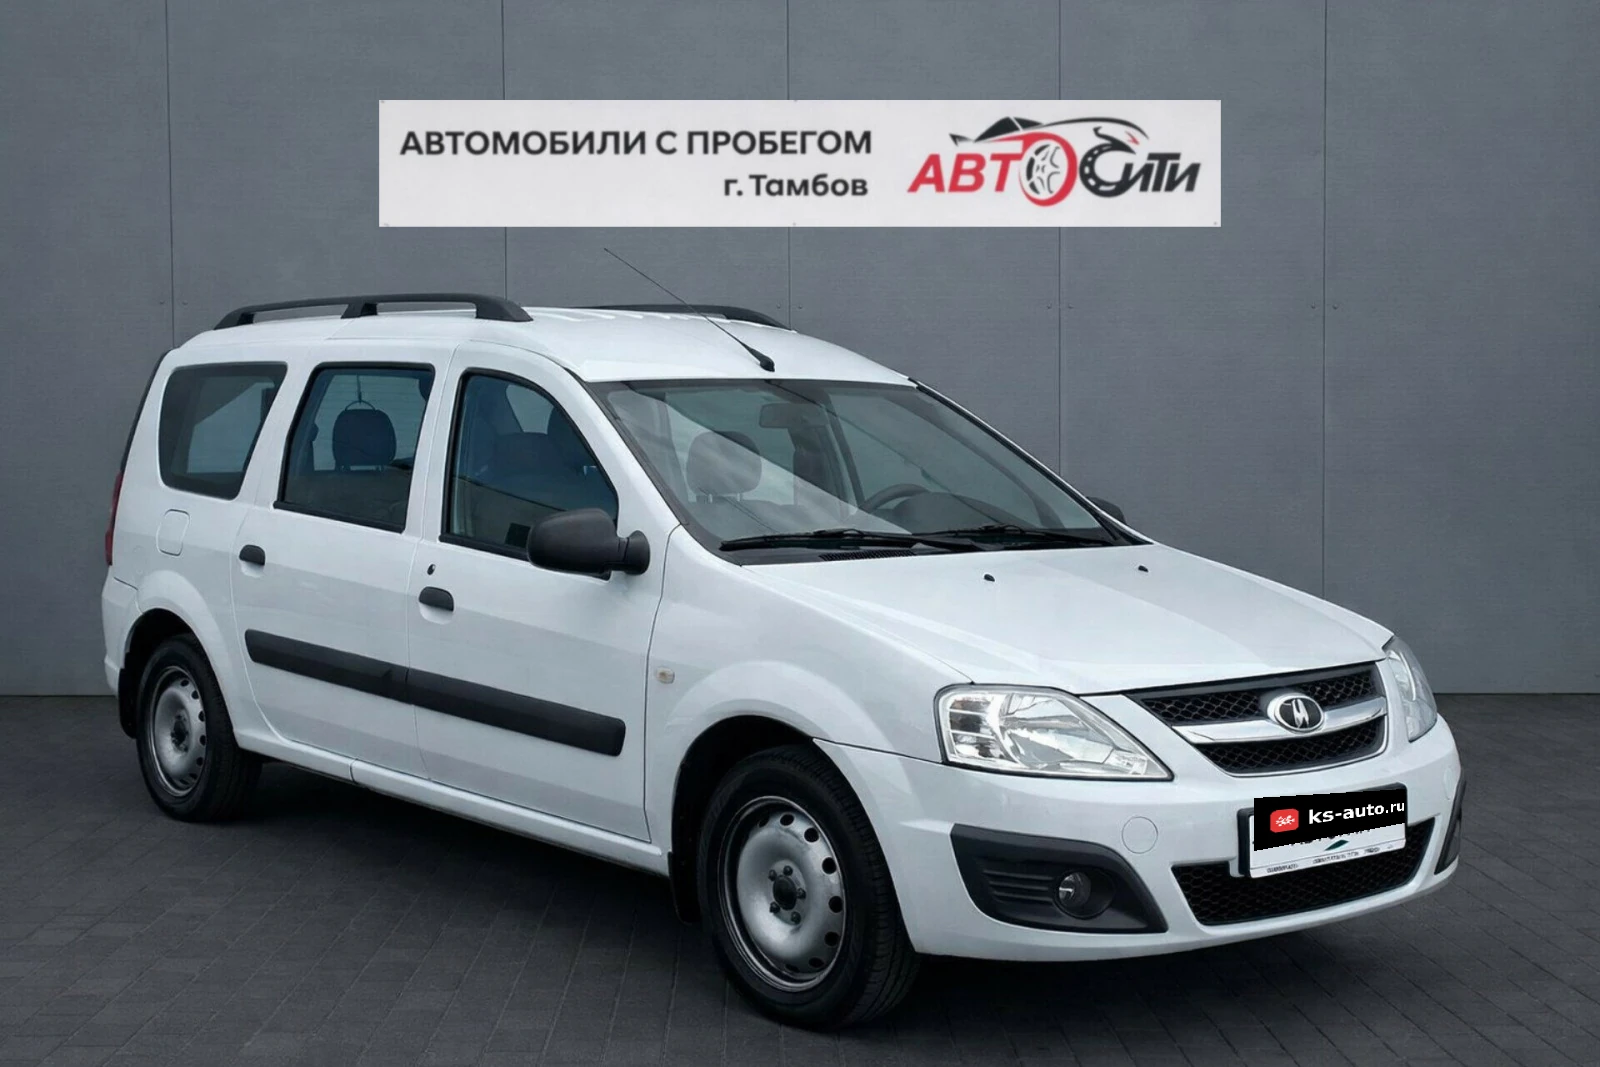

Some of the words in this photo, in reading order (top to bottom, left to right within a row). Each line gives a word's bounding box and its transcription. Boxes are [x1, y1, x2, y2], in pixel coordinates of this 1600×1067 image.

[399, 130, 647, 156] АВТОМОБИЛИ
[655, 130, 678, 156] С
[687, 130, 872, 156] ПРОБЕГОМ
[724, 178, 744, 197] г.
[748, 173, 869, 197] Тамбов
